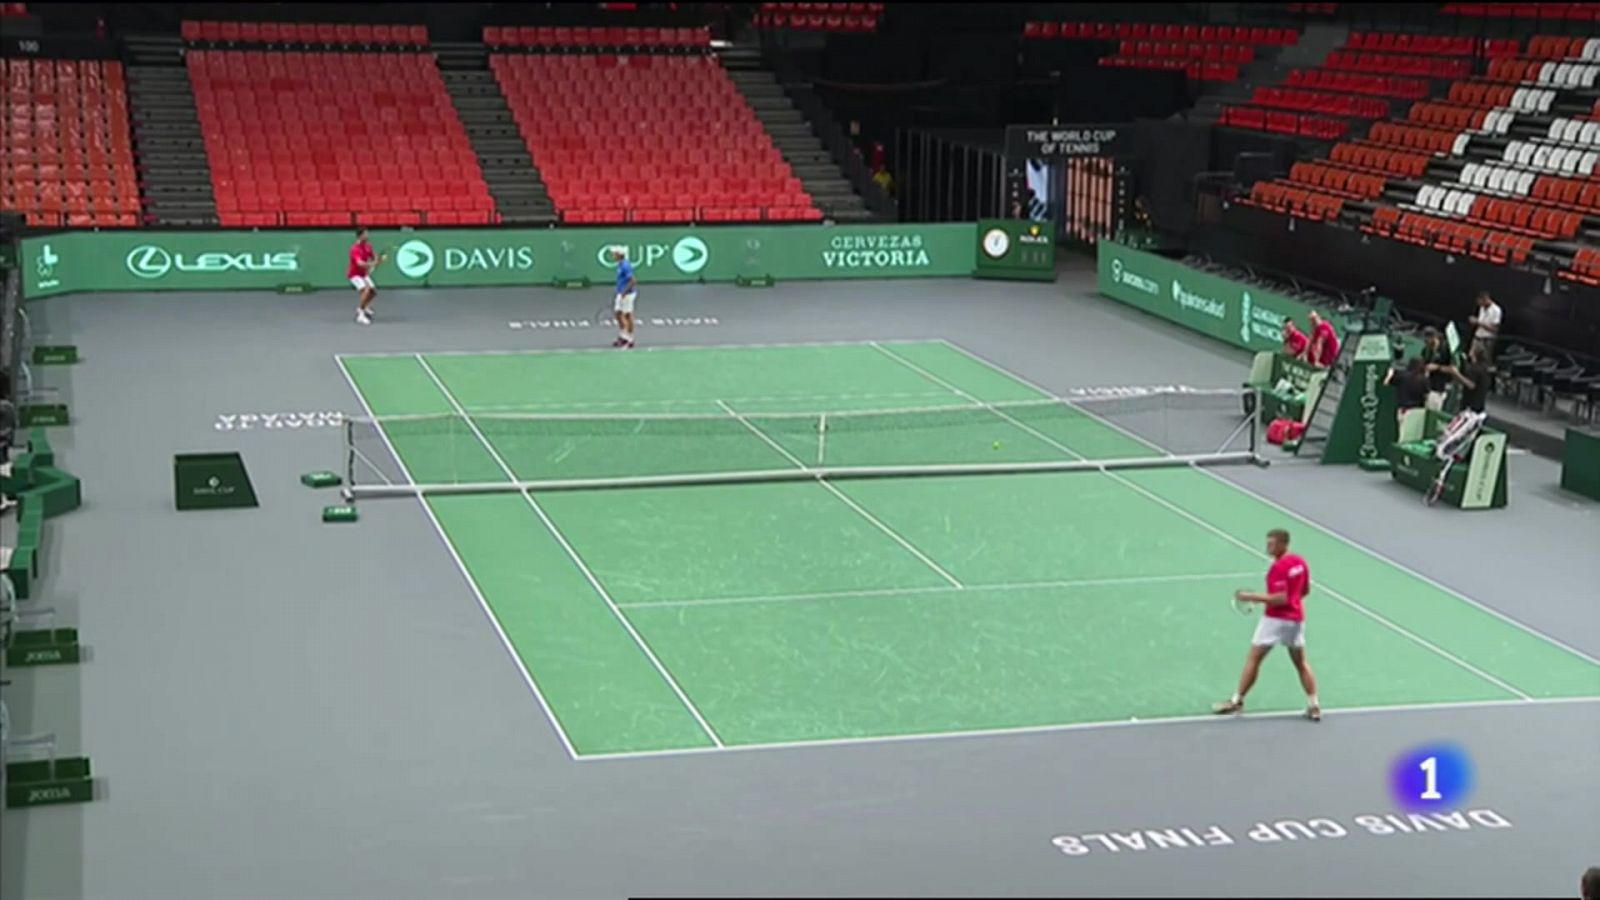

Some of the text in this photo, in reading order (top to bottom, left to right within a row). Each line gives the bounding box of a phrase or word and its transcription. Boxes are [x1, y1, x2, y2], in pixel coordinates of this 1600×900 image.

[1027, 130, 1116, 141] THE WORLD CUP
[1041, 143, 1100, 154] OF TENNIS
[831, 235, 922, 249] CERVEZAS
[175, 253, 298, 271] LEXUS
[445, 246, 533, 270] DAVIS
[823, 250, 930, 267] VICTORIA
[1051, 809, 1512, 856] DAVIS CUP FINALS
